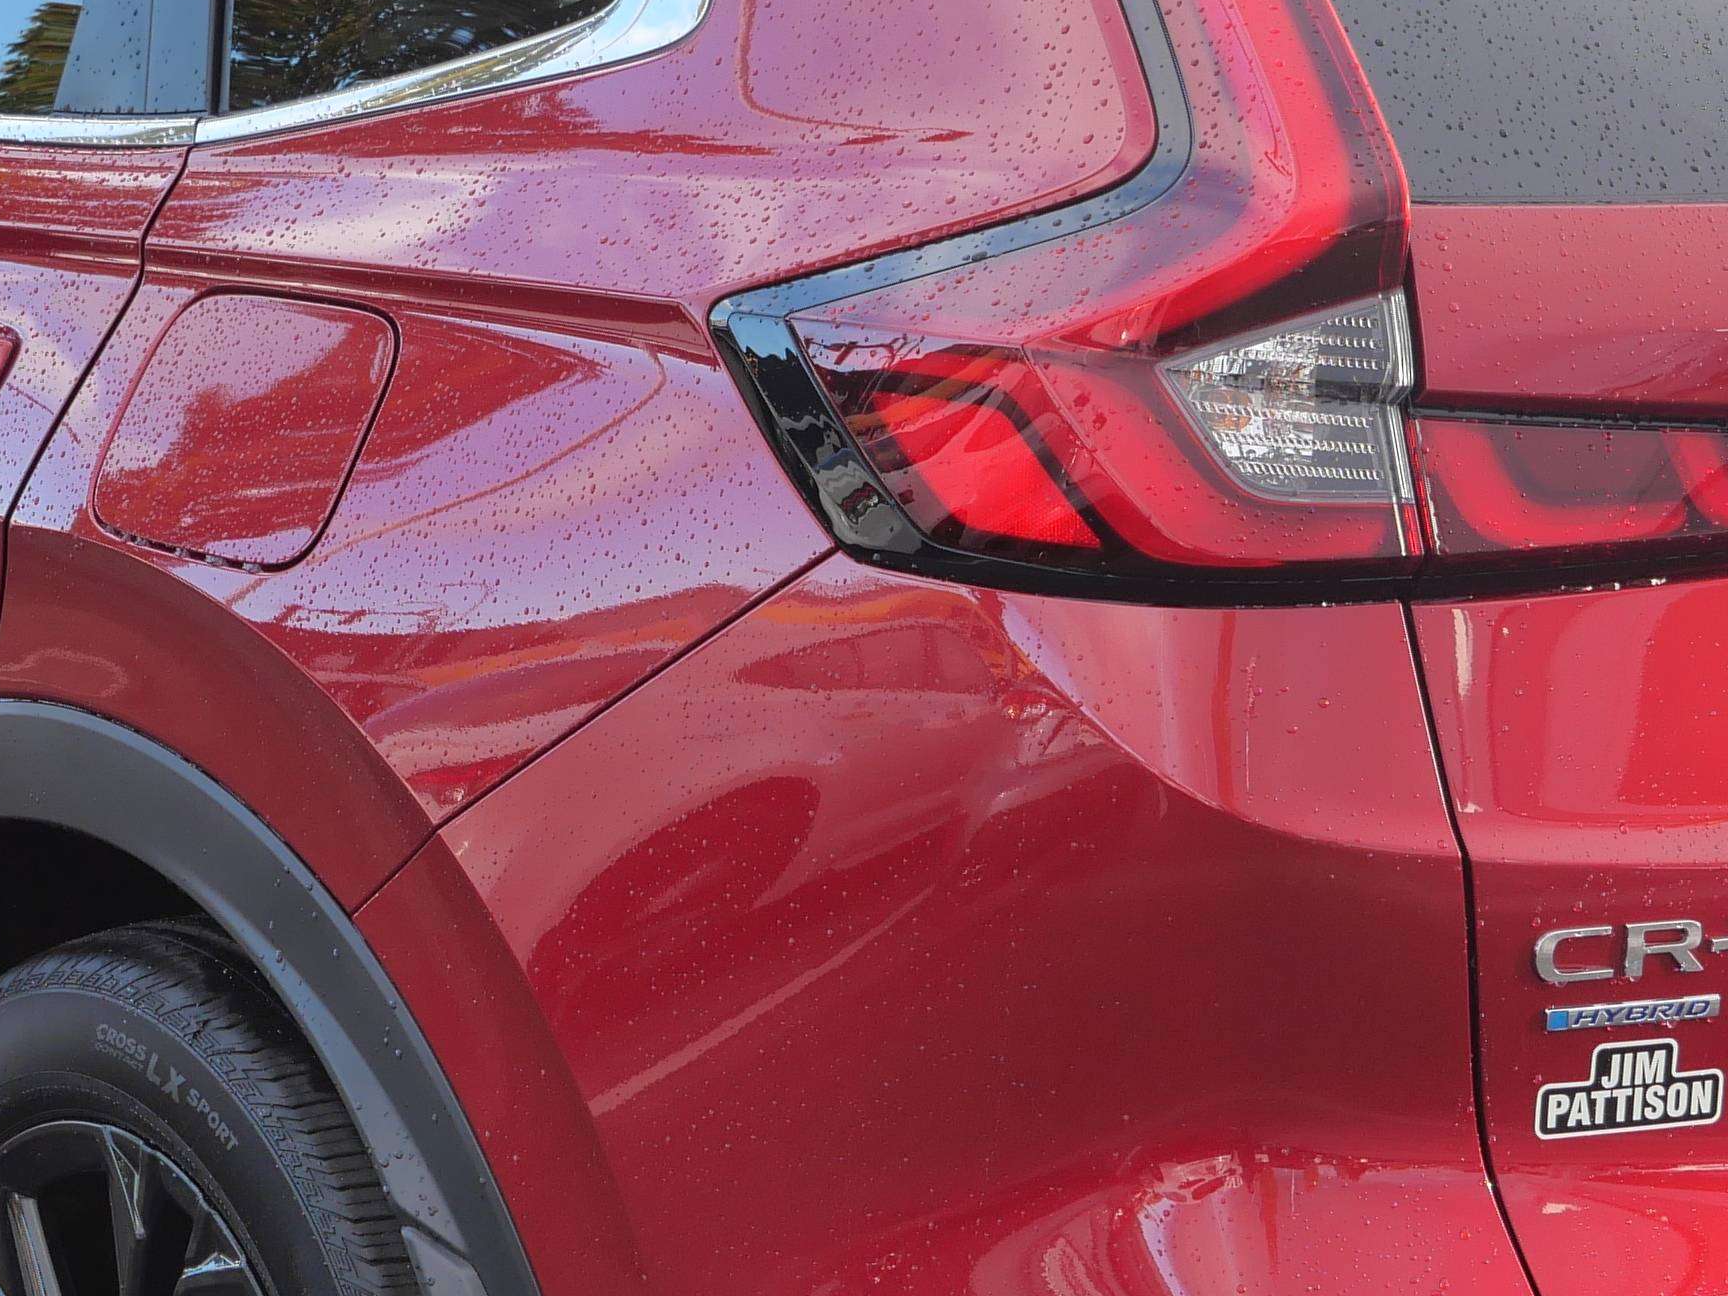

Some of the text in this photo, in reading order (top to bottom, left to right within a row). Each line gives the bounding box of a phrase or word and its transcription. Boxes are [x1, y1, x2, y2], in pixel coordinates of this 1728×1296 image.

[1571, 999, 1711, 1027] HYBRID
[95, 1023, 147, 1061] CROSS
[1601, 1049, 1667, 1089] JIM
[145, 1052, 240, 1152] LX SPORT
[1547, 1078, 1713, 1130] PATTISON
